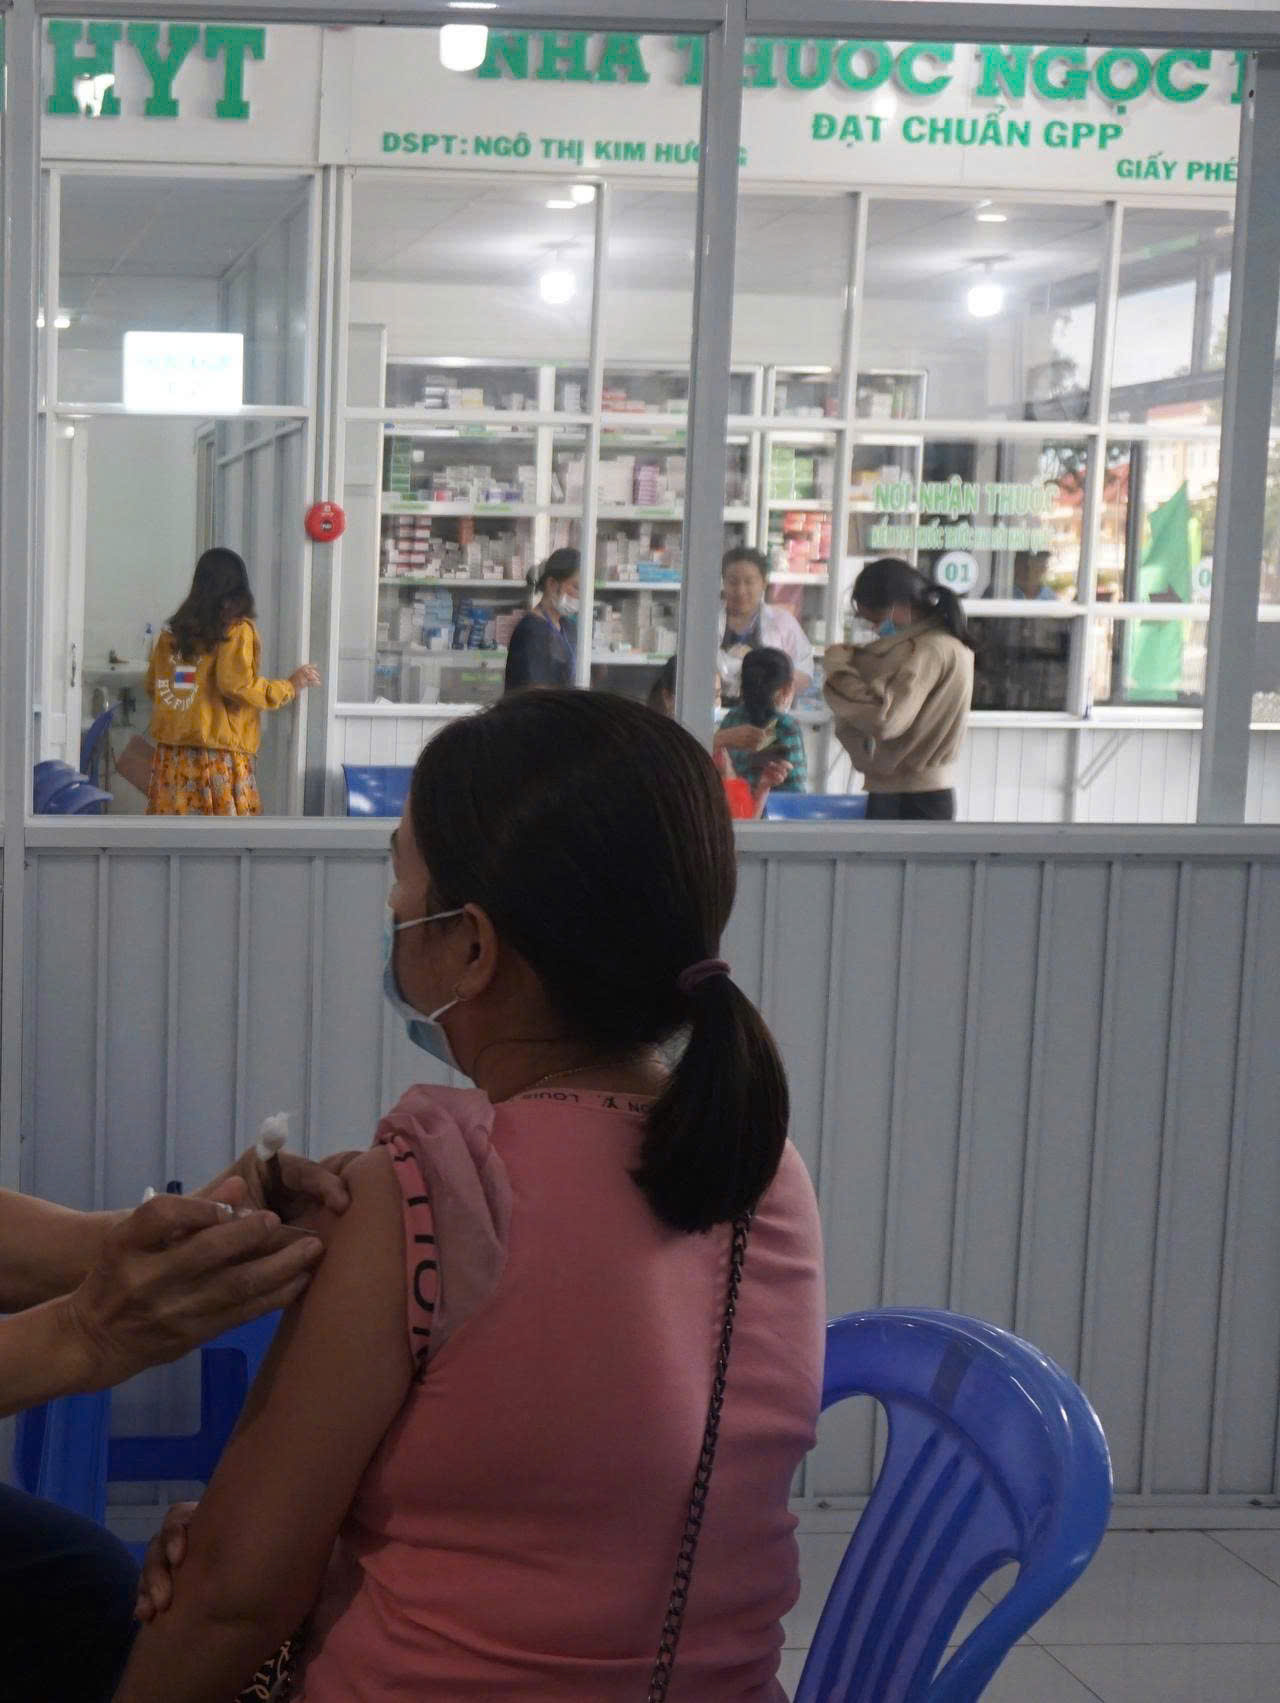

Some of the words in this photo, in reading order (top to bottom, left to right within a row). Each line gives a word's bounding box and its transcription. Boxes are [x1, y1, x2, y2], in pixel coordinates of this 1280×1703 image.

[973, 43, 1212, 115] NGỌC
[811, 113, 883, 148] ĐẠT
[902, 105, 1032, 148] CHUẨN
[1043, 120, 1124, 149] GPP
[474, 131, 532, 158] NGÔ
[540, 137, 584, 166] THỊ
[595, 140, 646, 161] KIM
[1116, 151, 1177, 181] GIẤY
[944, 562, 970, 584] 01
